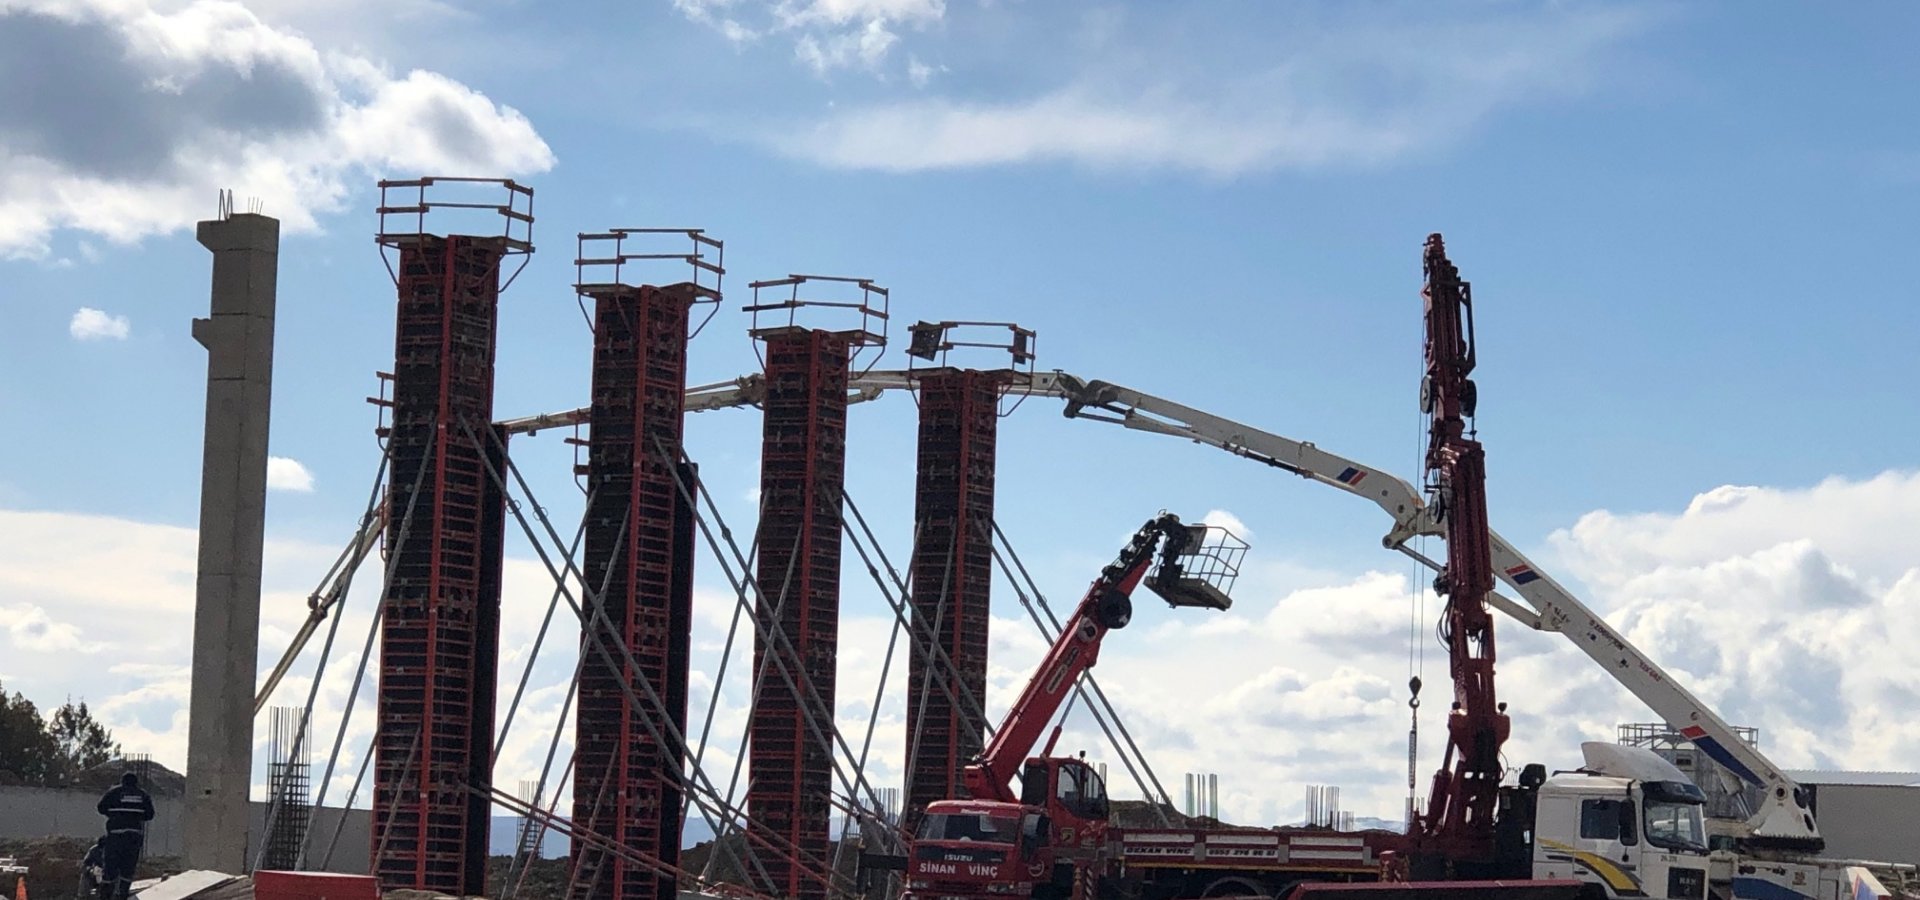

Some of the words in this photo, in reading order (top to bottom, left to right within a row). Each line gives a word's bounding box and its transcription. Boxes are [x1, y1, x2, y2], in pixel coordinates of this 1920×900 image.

[944, 854, 973, 862] ISUZU
[919, 860, 956, 874] SİNAN
[968, 863, 998, 878] VİNÇ
